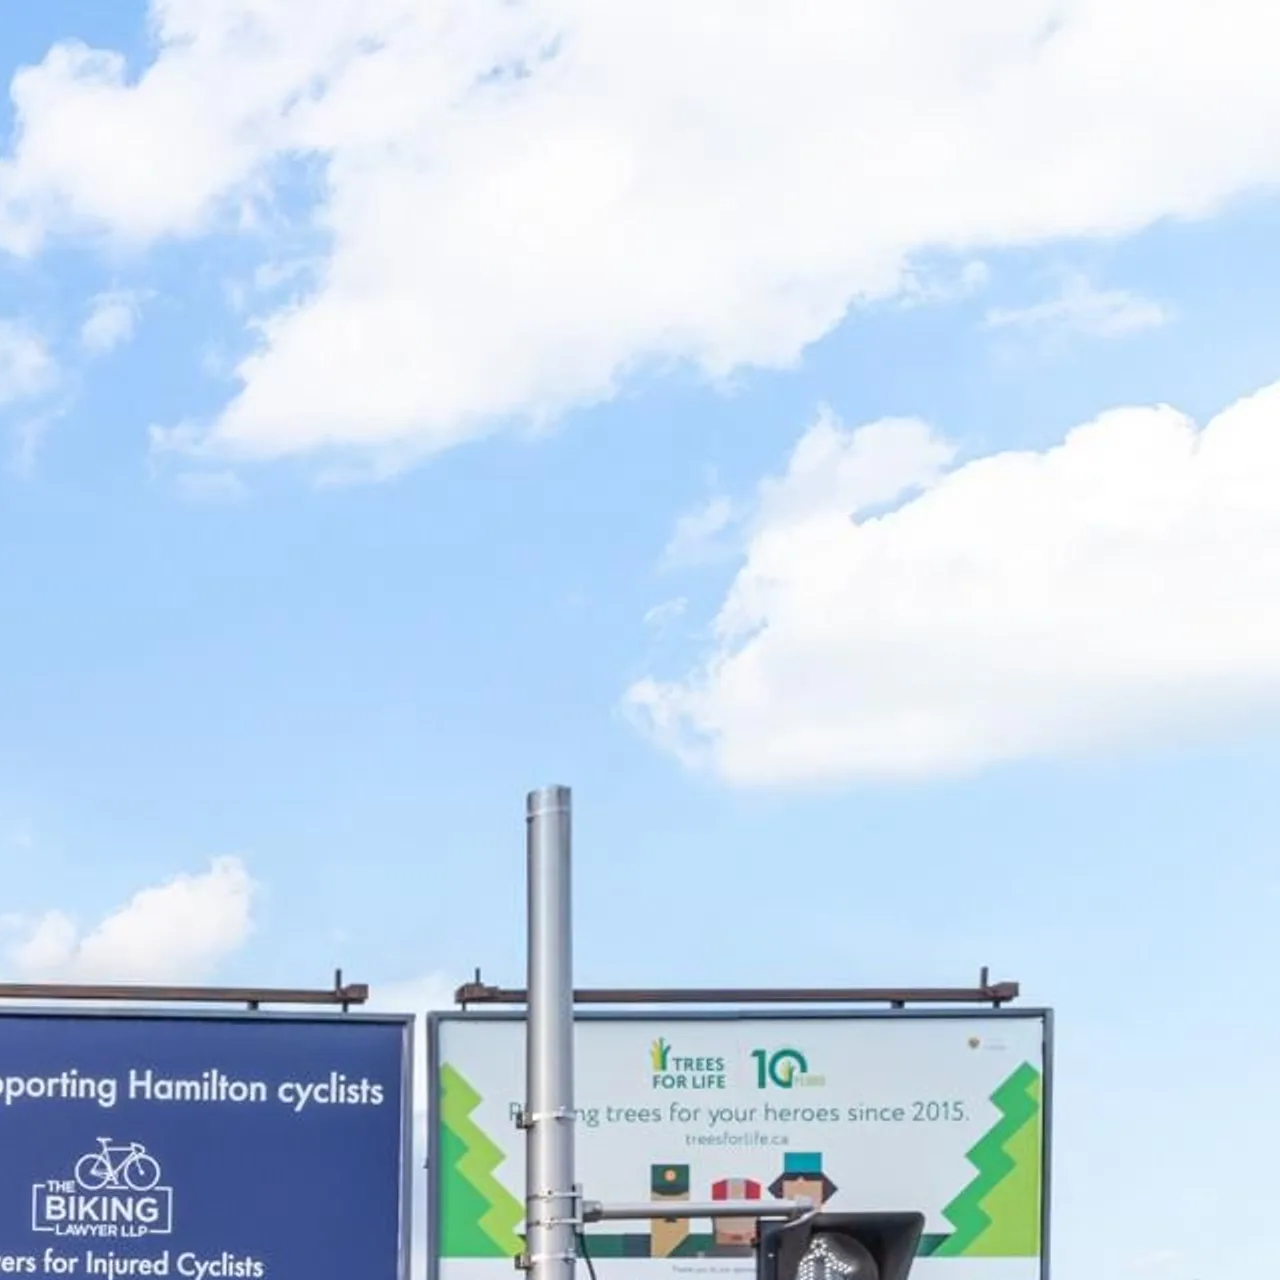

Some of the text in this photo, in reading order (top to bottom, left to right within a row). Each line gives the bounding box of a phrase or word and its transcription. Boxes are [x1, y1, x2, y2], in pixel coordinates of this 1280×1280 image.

[672, 1057, 725, 1072] TREES
[751, 1048, 808, 1089] 10
[128, 1069, 267, 1102] Hamilton
[278, 1072, 384, 1112] cyclists
[653, 1074, 726, 1090] FOR LIFE
[607, 1104, 661, 1122] trees
[669, 1102, 701, 1122] for
[708, 1107, 758, 1128] your
[764, 1102, 839, 1122] heroes
[848, 1102, 905, 1122] since
[912, 1101, 970, 1122] 2015.
[685, 1132, 790, 1147] treesforlife.ca
[46, 1180, 75, 1193] THE
[45, 1196, 159, 1222] BIKING
[56, 1224, 147, 1238] LAWYER LLP
[44, 1248, 79, 1274] for
[86, 1250, 169, 1280] Injured
